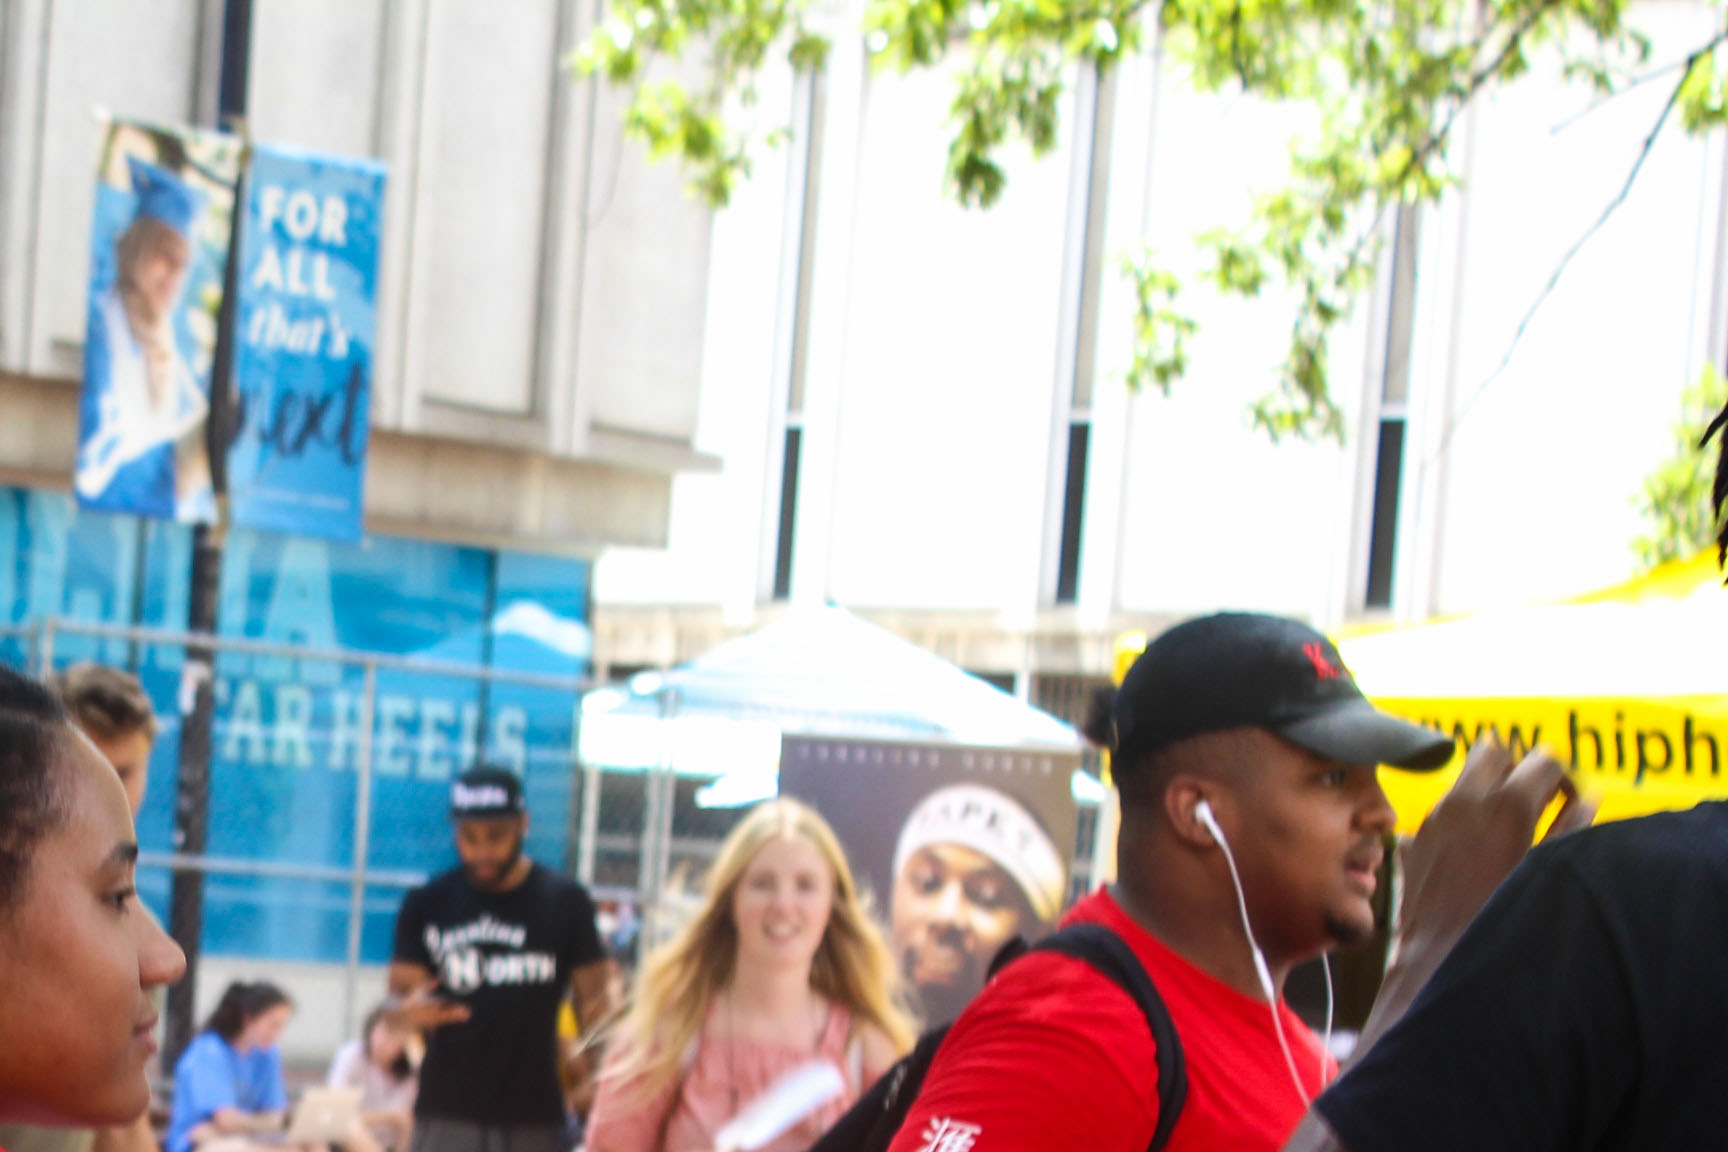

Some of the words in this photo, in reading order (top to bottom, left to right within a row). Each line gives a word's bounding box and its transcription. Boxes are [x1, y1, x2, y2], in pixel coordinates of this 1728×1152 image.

[260, 186, 349, 247] FOR
[252, 244, 335, 300] ALL
[217, 676, 313, 770] AR
